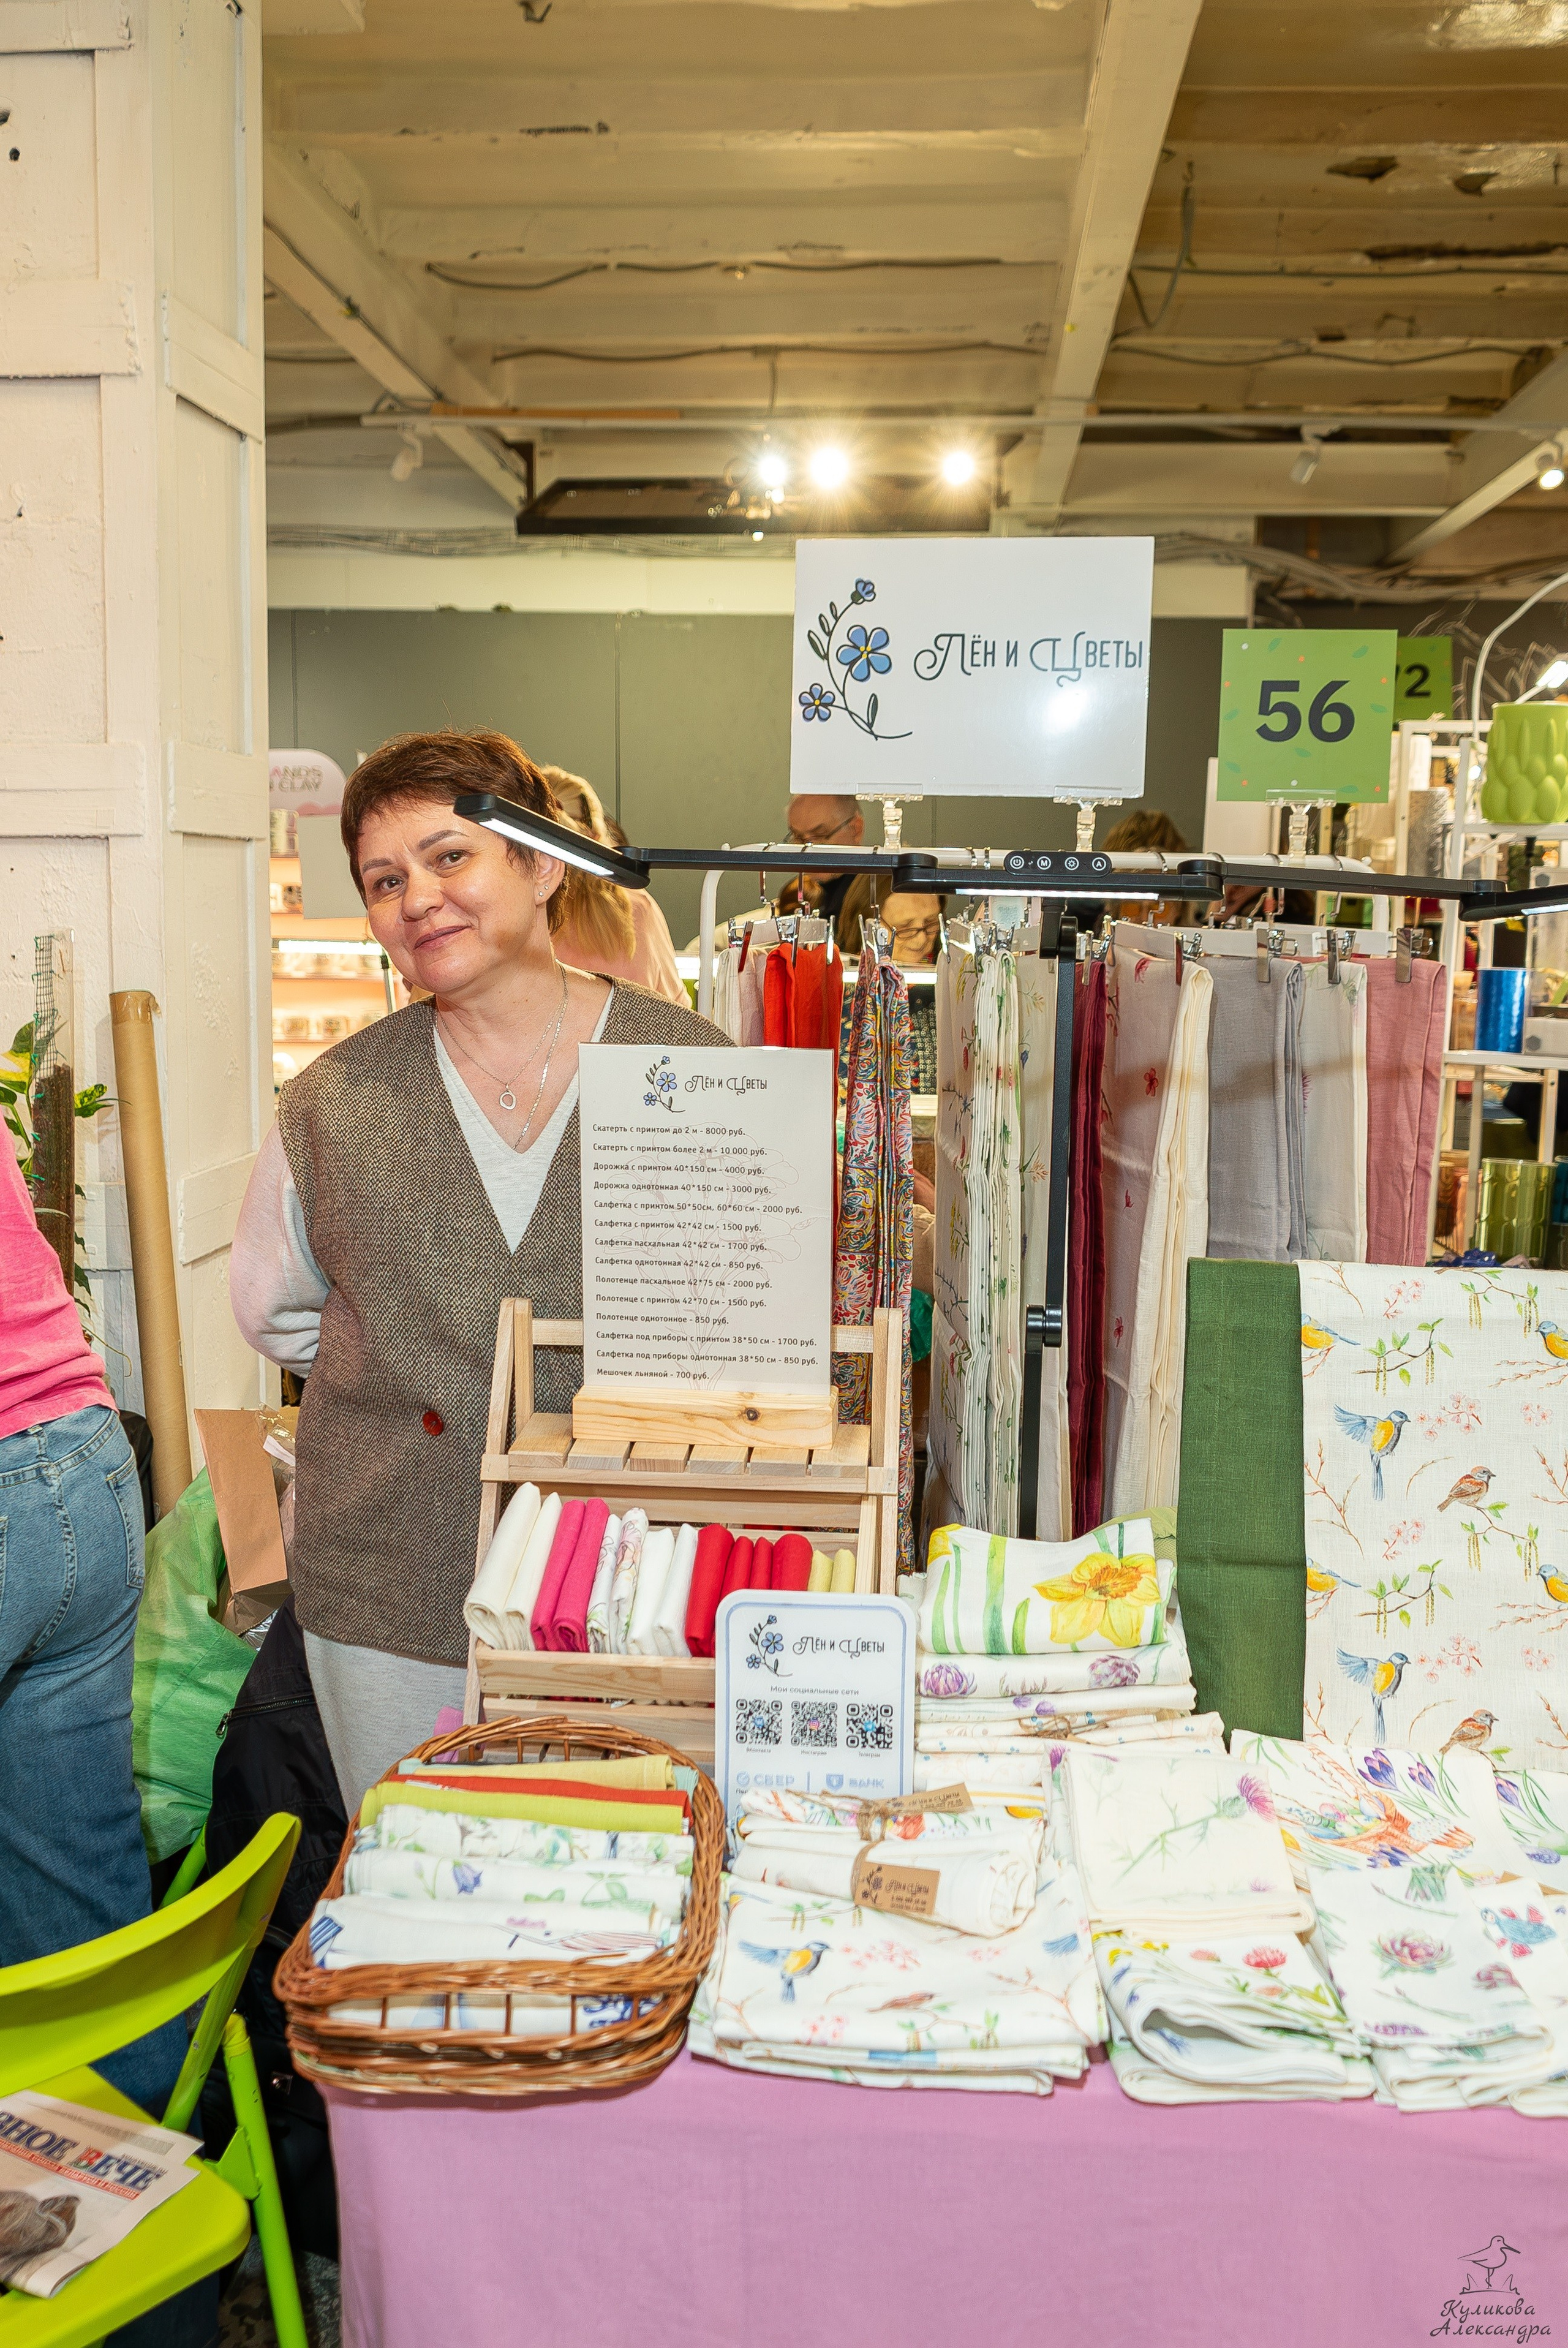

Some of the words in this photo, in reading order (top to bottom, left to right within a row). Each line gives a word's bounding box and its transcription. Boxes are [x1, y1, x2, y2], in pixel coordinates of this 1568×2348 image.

[1395, 664, 1431, 698] 2
[1256, 680, 1355, 742] 56
[592, 1124, 627, 1133] Скатерть
[728, 1128, 746, 1137] руб.
[593, 1143, 628, 1152] Скатерть
[750, 1147, 767, 1157] руб.
[593, 1162, 629, 1171] Дорожка
[747, 1166, 764, 1176] руб.
[594, 1181, 629, 1190] Дорожка
[755, 1186, 771, 1195] руб.
[594, 1200, 631, 1209] Салфетка
[785, 1206, 802, 1215] руб.
[594, 1219, 632, 1228] Салфетка
[745, 1223, 761, 1233] руб.
[595, 1238, 632, 1247] Салфетка
[750, 1243, 767, 1251] руб.
[595, 1256, 632, 1266] Салфетка
[746, 1261, 763, 1270] руб.
[596, 1275, 638, 1284] Полотенце
[755, 1280, 772, 1289] руб.
[596, 1294, 638, 1302] Полотенце
[750, 1299, 766, 1308] руб.
[596, 1313, 638, 1321] Полотенце
[712, 1316, 729, 1326] руб.
[596, 1331, 633, 1340] Салфетка
[652, 1334, 688, 1342] приборы
[800, 1338, 816, 1347] руб.
[597, 1350, 633, 1358] Салфетка
[652, 1352, 688, 1361] приборы
[801, 1357, 818, 1366] руб.
[693, 1372, 709, 1380] руб.
[67, 2146, 166, 2191] ВЕЧЕ
